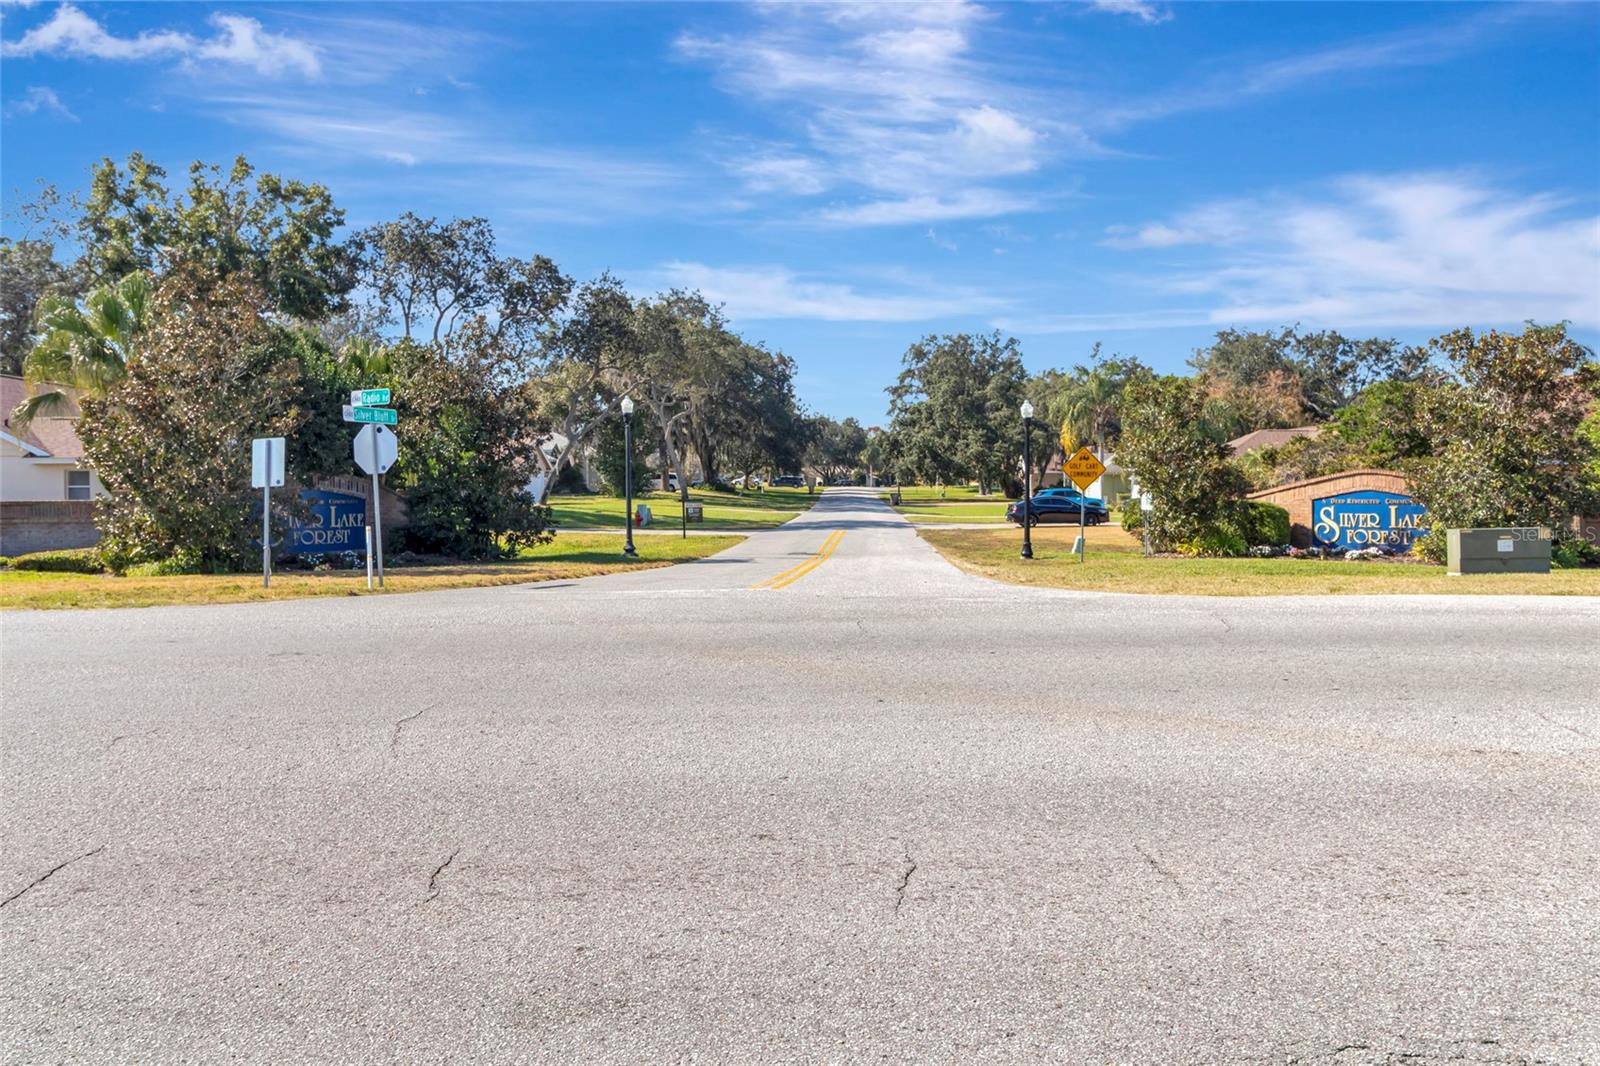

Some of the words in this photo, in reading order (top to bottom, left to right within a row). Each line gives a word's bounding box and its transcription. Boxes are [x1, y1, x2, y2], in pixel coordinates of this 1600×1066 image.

[362, 392, 381, 404] Radio
[354, 408, 372, 421] Silver
[373, 409, 389, 422] Bluff
[329, 505, 364, 529] LAKE
[1313, 505, 1381, 545] SILVER
[293, 529, 351, 546] FOREST
[1346, 528, 1413, 545] FOREST
